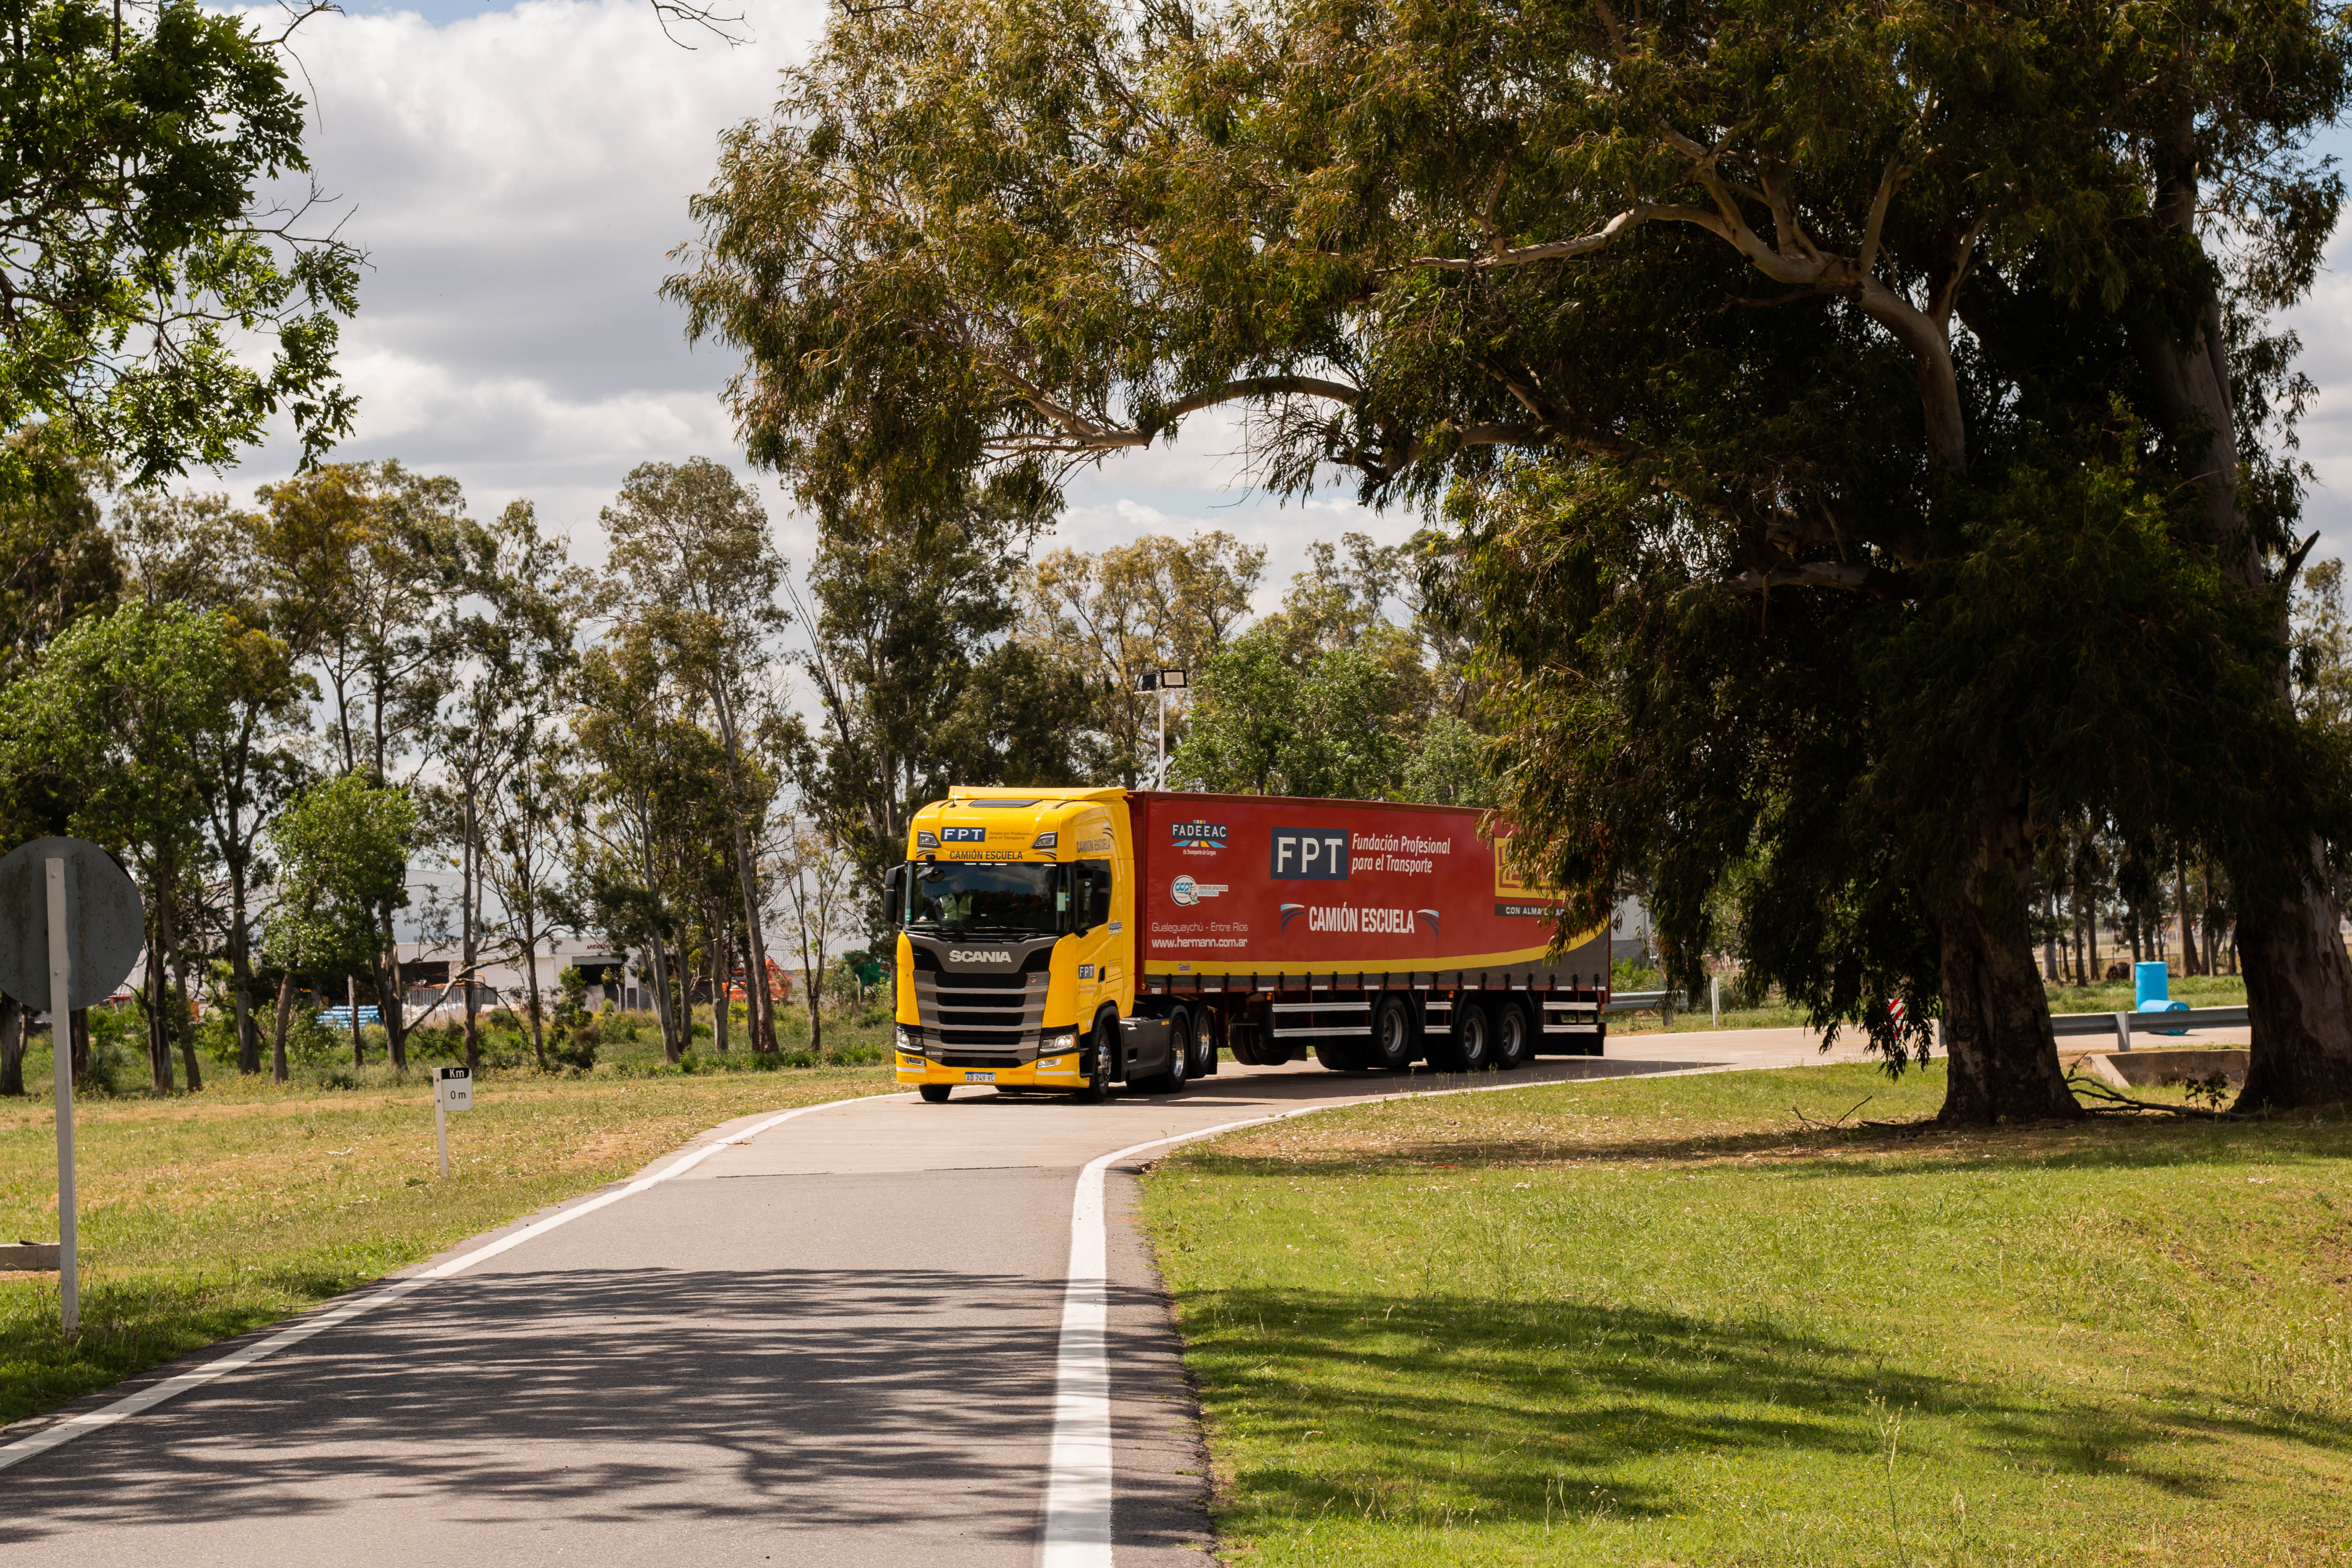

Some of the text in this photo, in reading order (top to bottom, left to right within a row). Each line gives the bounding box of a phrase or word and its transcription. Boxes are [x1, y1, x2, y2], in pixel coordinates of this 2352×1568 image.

[943, 829, 983, 840] FPT
[1172, 824, 1226, 837] FADEEAC
[1076, 836, 1111, 853] CAMIÓN ESCUELA
[1352, 833, 1451, 857] Fundación Profesional
[950, 849, 1023, 859] CAMIÓN ESCUELA
[1277, 837, 1343, 874] FPT
[1351, 854, 1432, 876] para el Transporte
[1309, 902, 1415, 933] CAMIÓN ESCUELA
[1152, 922, 1203, 933] Gualeguaychú
[1211, 922, 1231, 931] Entre
[1151, 936, 1248, 948] www.hermann.com.ar
[949, 950, 1012, 963] SCANIA
[1079, 966, 1093, 977] FPT
[450, 1069, 464, 1078] Km
[450, 1090, 456, 1100] 0
